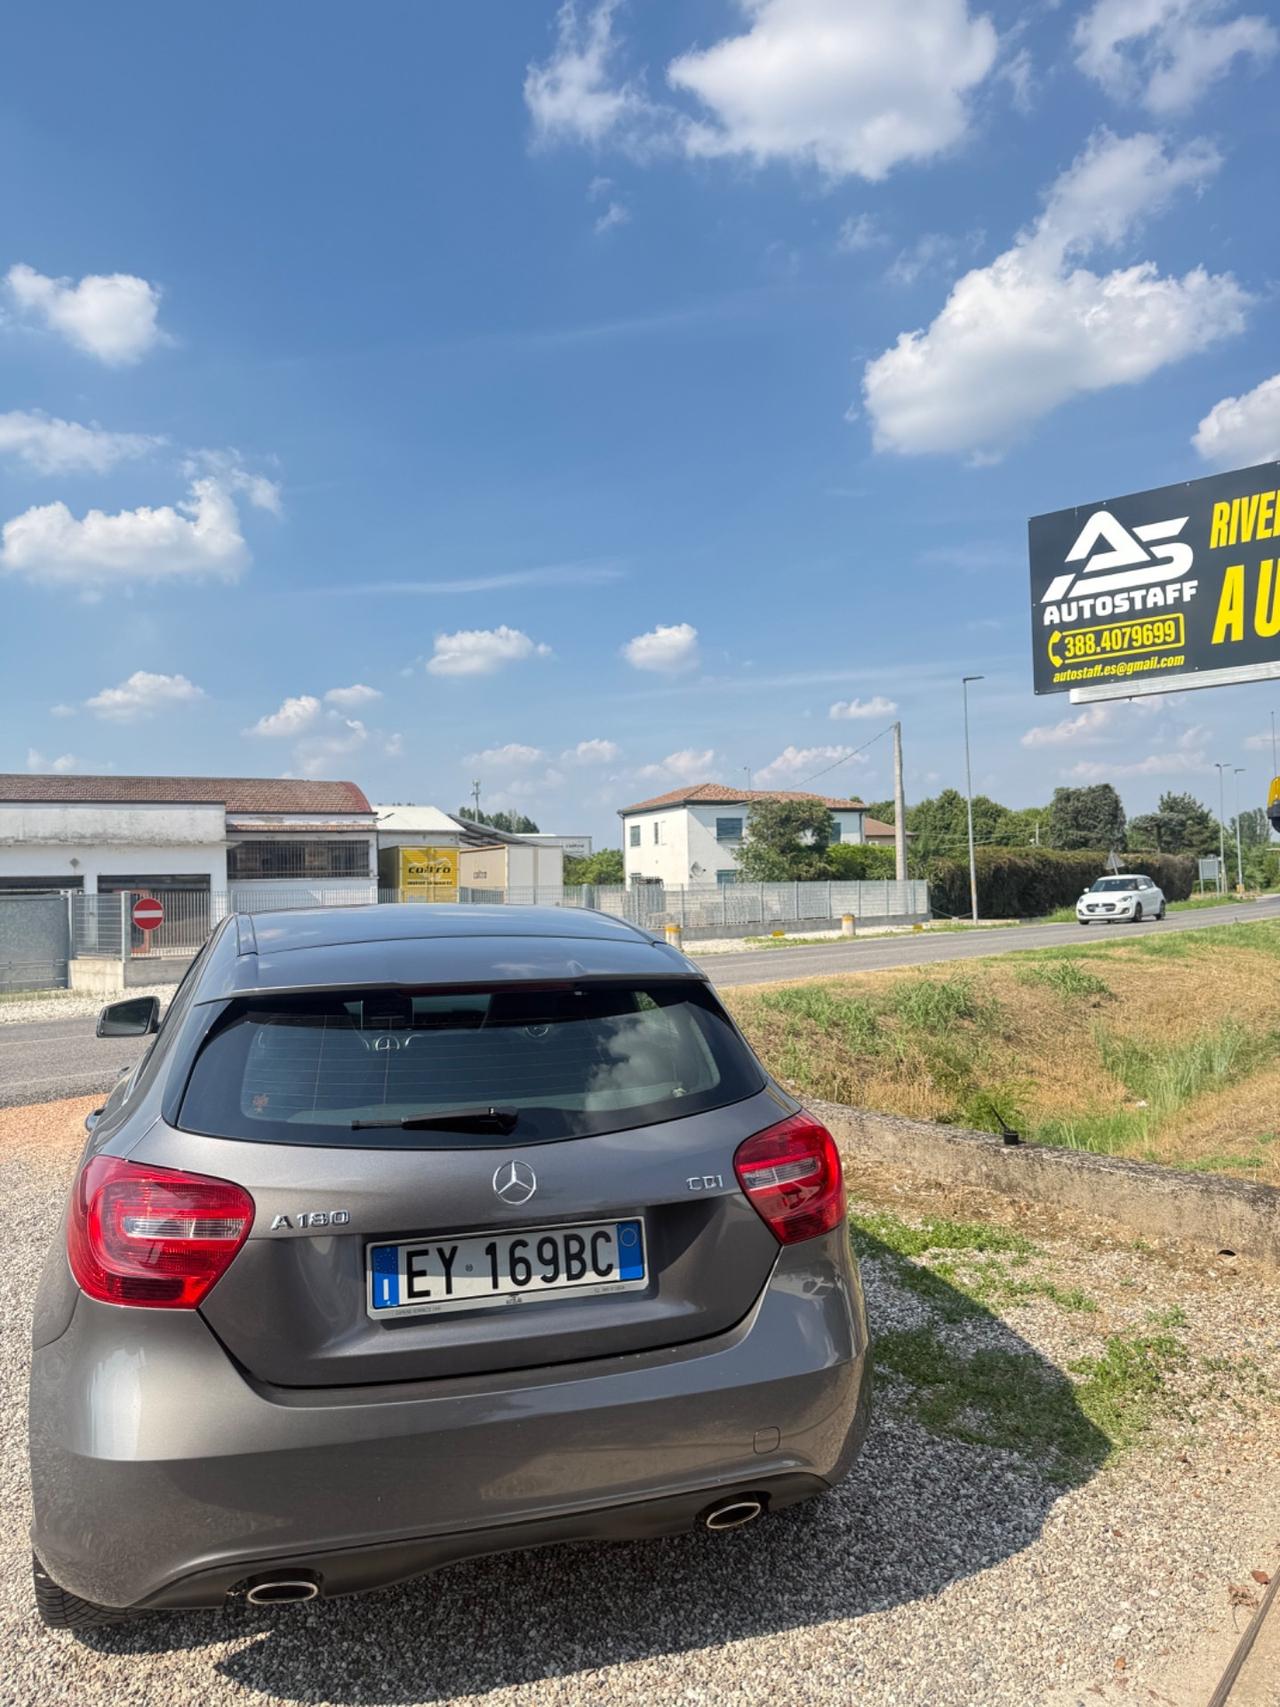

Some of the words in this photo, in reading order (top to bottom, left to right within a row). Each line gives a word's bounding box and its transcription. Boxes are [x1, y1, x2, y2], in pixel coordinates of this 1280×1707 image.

[1209, 489, 1280, 549] RIVE
[1043, 580, 1199, 626] AUTOSTAFF
[1064, 620, 1176, 658] 388.4079699
[1053, 655, 1185, 683] autostaff.es@gmail.com
[686, 1174, 723, 1191] CDI
[271, 1214, 294, 1231] A
[296, 1209, 351, 1228] 180
[406, 1245, 459, 1299] EY
[485, 1231, 614, 1290] 169BC
